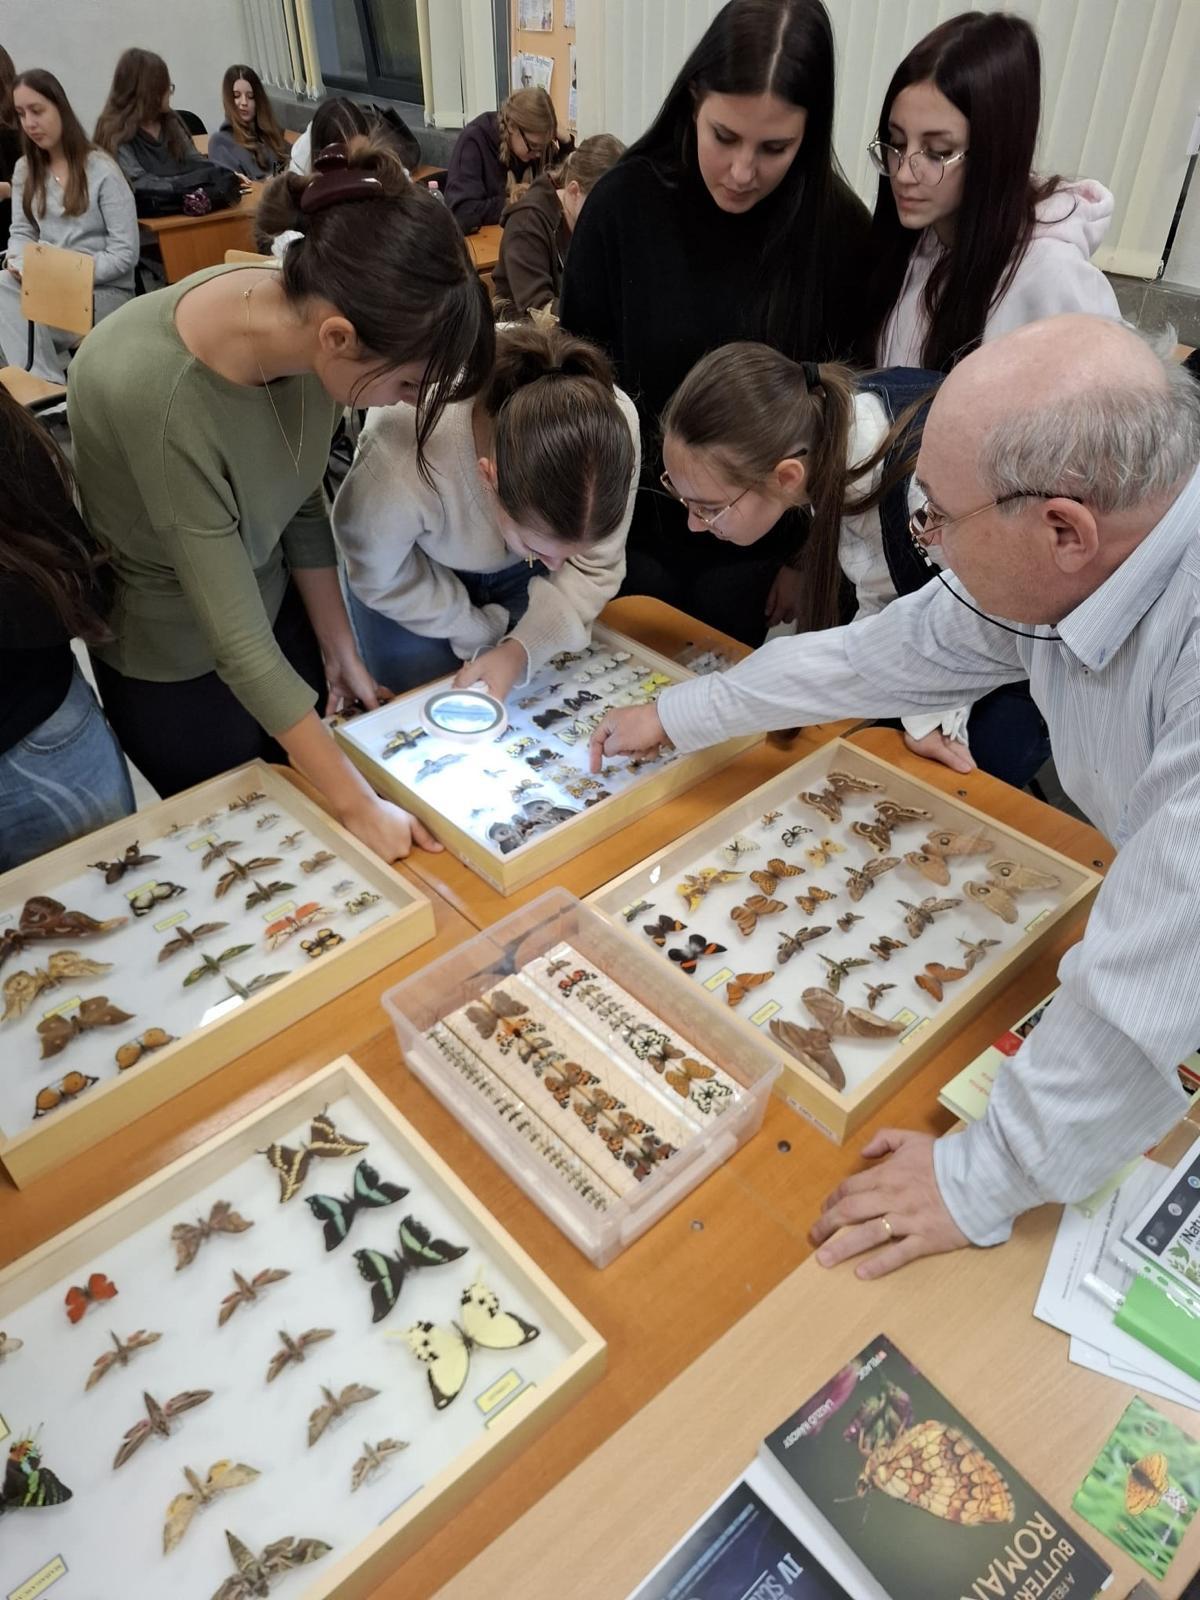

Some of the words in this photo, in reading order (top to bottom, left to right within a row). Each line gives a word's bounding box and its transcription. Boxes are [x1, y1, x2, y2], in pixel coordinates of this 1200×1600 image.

[777, 1552, 804, 1585] IV
[1013, 1538, 1076, 1600] BUTTER
[746, 1574, 784, 1600] SCI
